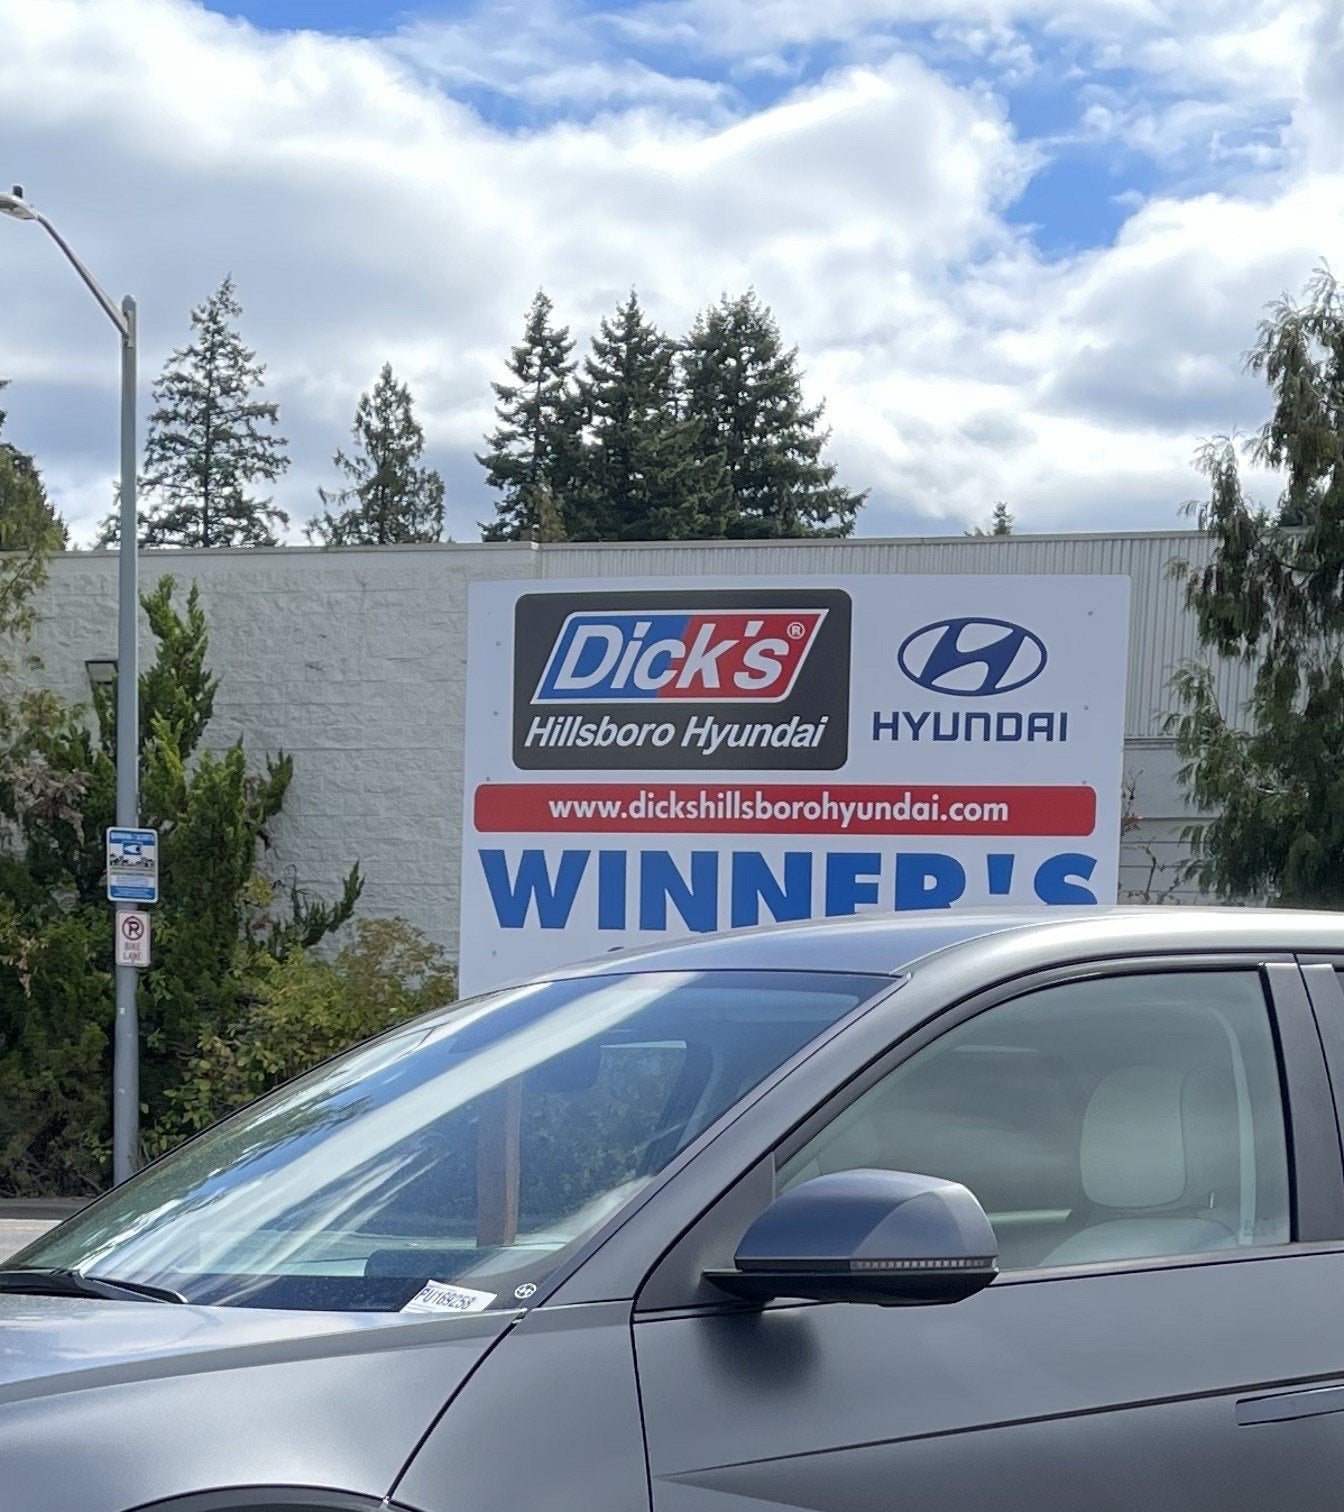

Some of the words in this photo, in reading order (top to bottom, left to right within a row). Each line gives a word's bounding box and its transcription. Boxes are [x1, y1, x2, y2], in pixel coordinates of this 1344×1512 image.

[523, 715, 675, 748] Hillsboro
[680, 715, 829, 755] Hyundai
[872, 711, 1068, 742] HYUNDAI
[548, 790, 1009, 828] www.dickshillsborohyundai.com
